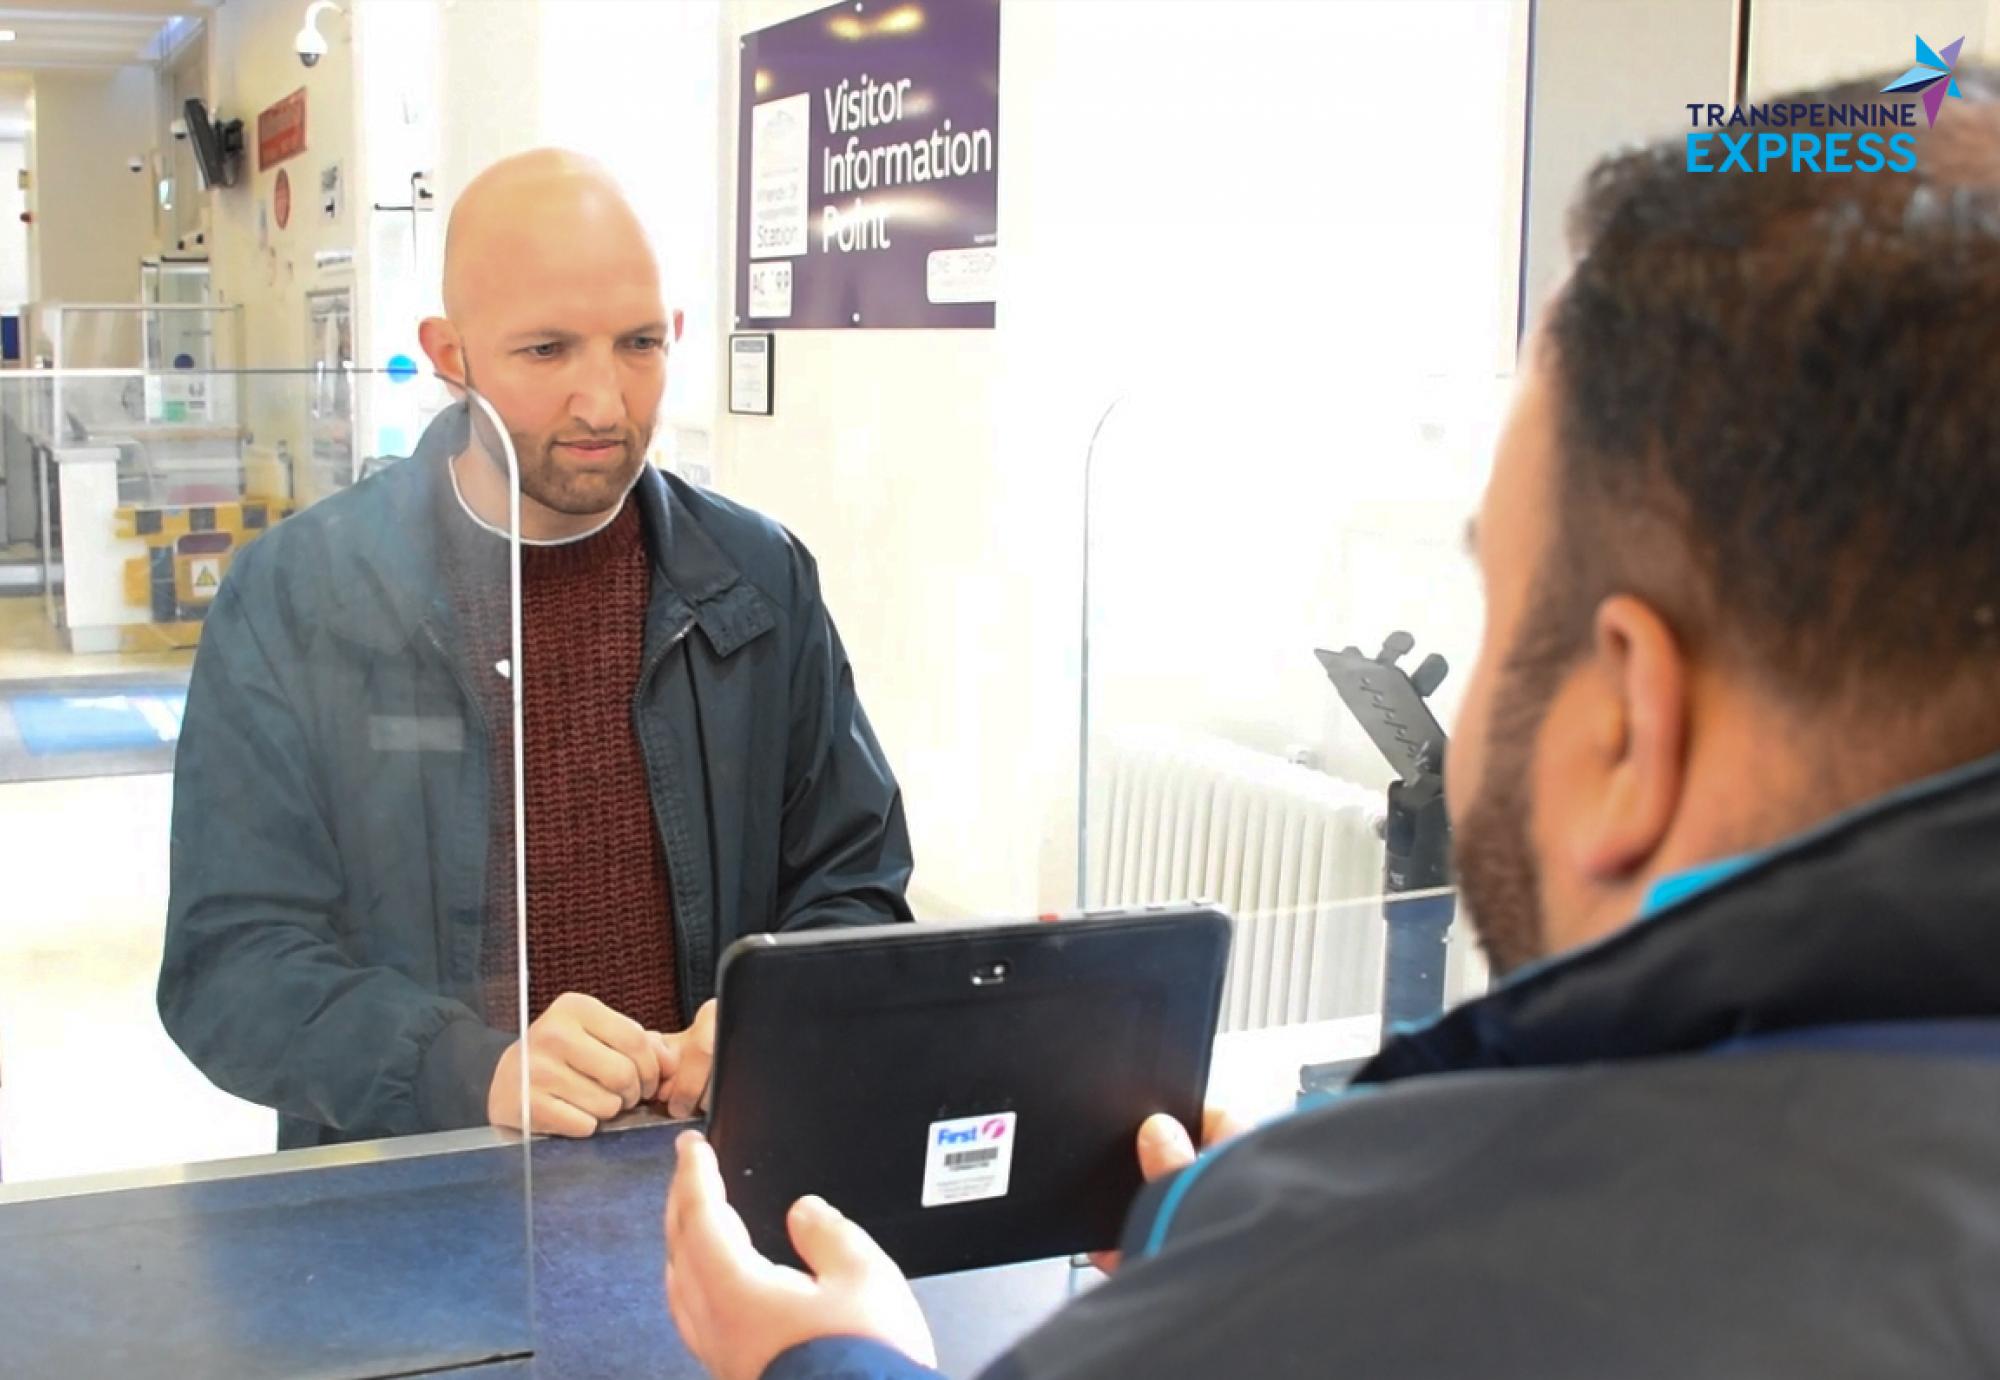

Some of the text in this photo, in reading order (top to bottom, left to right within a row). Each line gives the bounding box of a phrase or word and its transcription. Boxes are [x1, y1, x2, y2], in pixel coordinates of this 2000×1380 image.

[824, 73, 911, 134] Visitor
[823, 119, 992, 194] Information
[823, 197, 891, 253] Point
